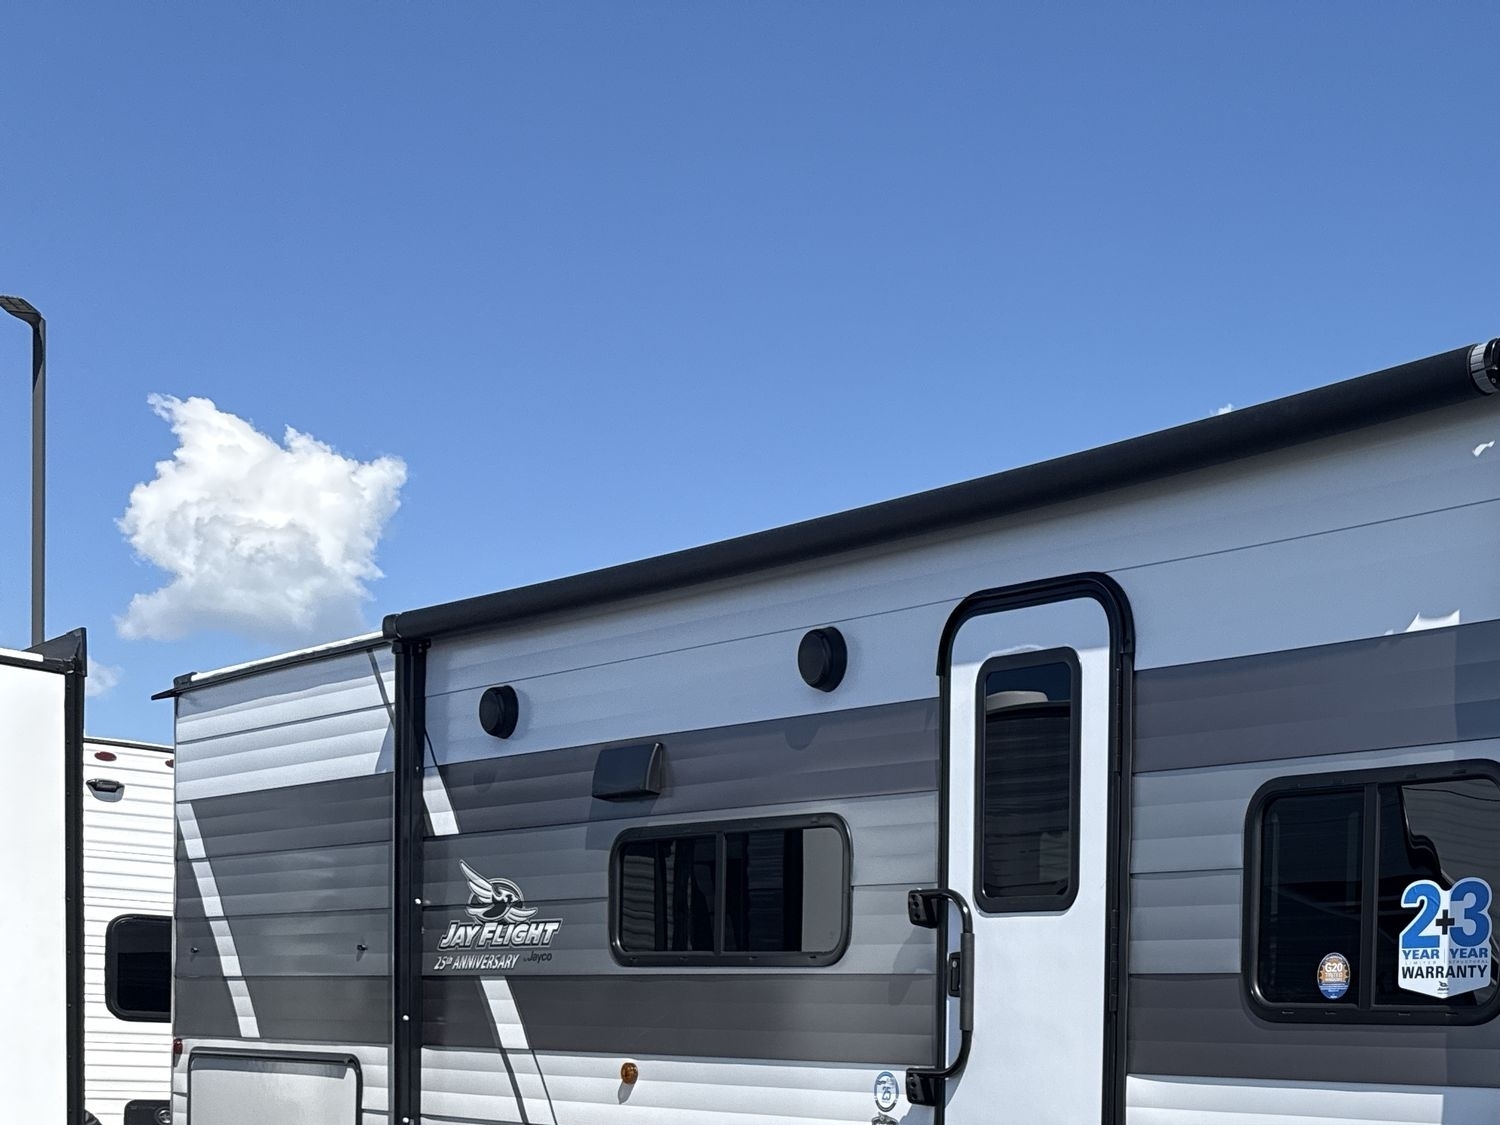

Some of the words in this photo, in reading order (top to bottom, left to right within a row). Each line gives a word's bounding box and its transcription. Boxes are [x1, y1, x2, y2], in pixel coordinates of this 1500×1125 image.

[439, 922, 480, 948] JAY
[478, 920, 562, 947] FLIGHT
[1402, 949, 1440, 960] YEAR
[1449, 948, 1489, 959] YEAR
[452, 953, 520, 970] ANNIVERSARY
[1325, 962, 1343, 972] G20
[1401, 965, 1488, 979] WARRANTY
